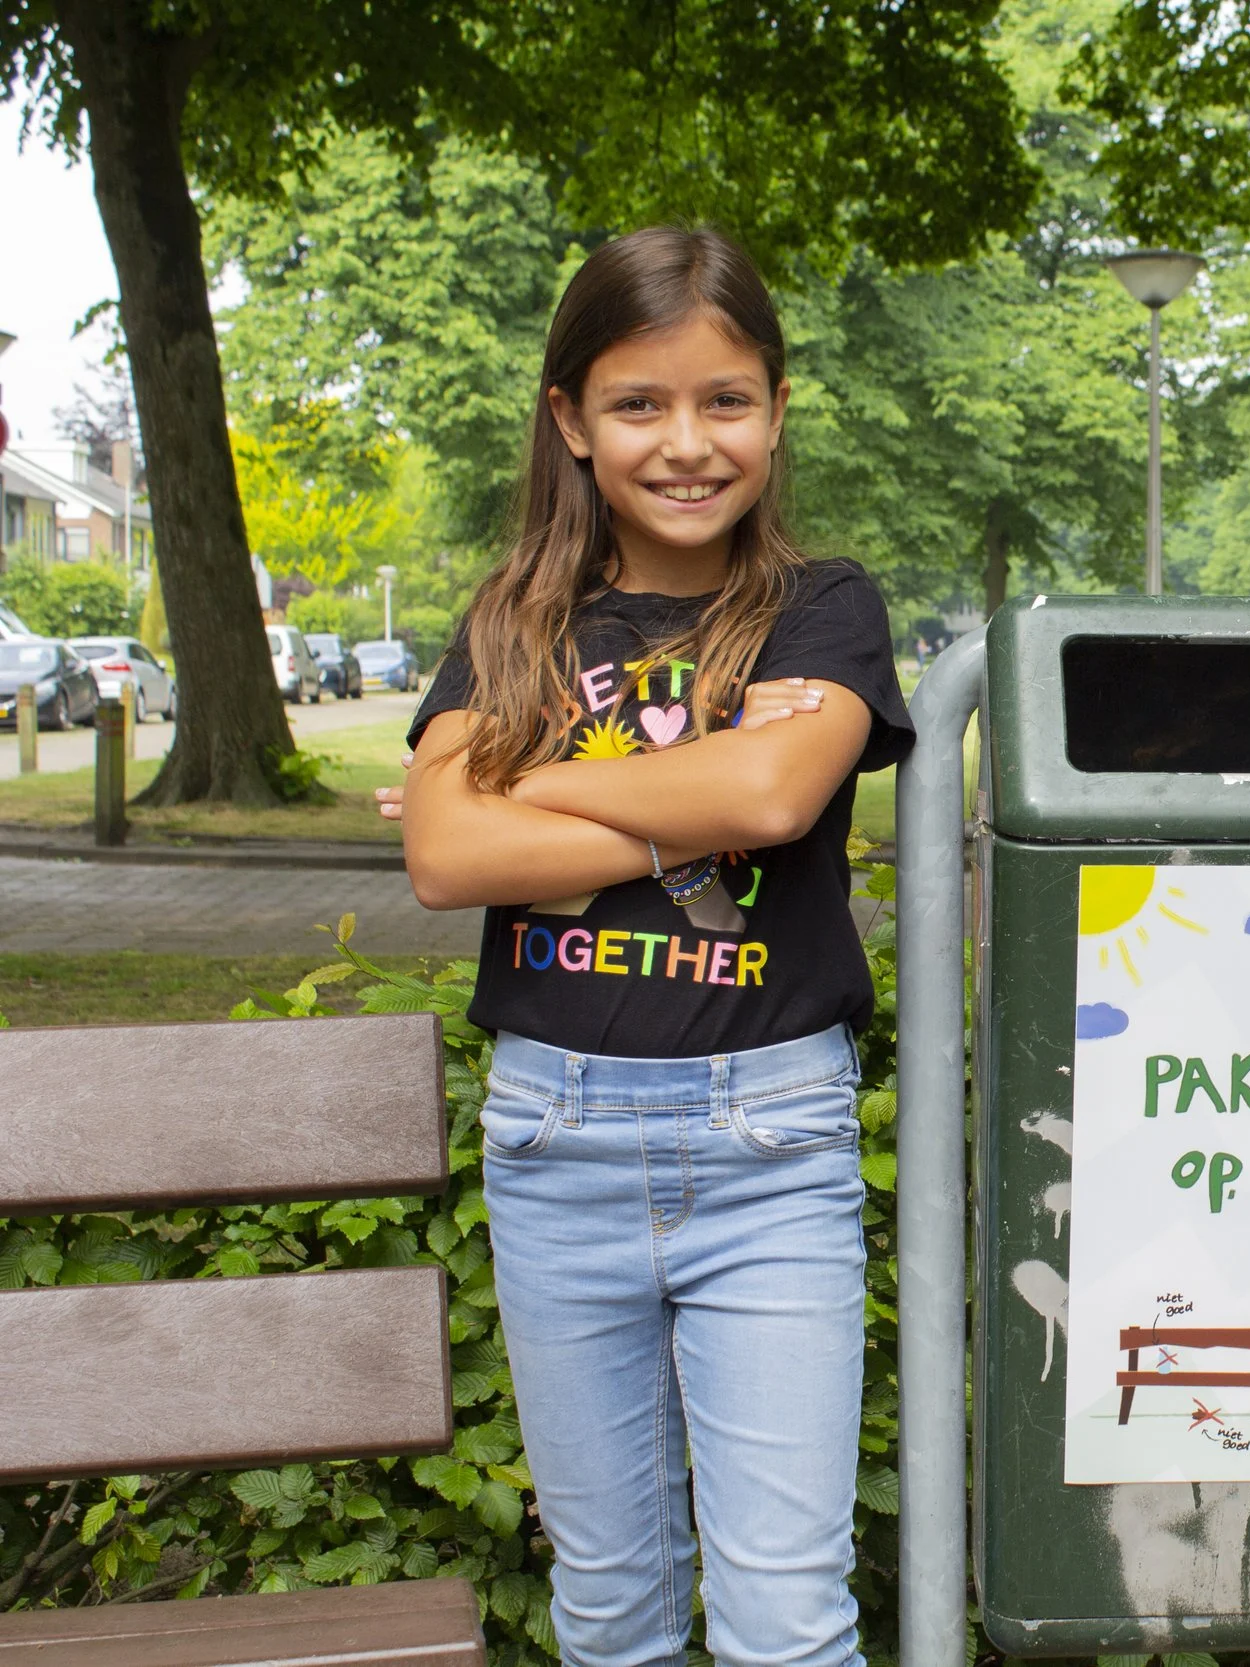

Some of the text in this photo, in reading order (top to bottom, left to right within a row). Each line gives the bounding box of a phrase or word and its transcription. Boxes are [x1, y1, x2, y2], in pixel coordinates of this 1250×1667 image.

[540, 654, 744, 739] ETT
[512, 922, 769, 987] TOGETHER
[1156, 1292, 1184, 1303] niet
[1165, 1300, 1193, 1318] goed
[1217, 1427, 1243, 1441] niet
[1222, 1438, 1250, 1451] goed
